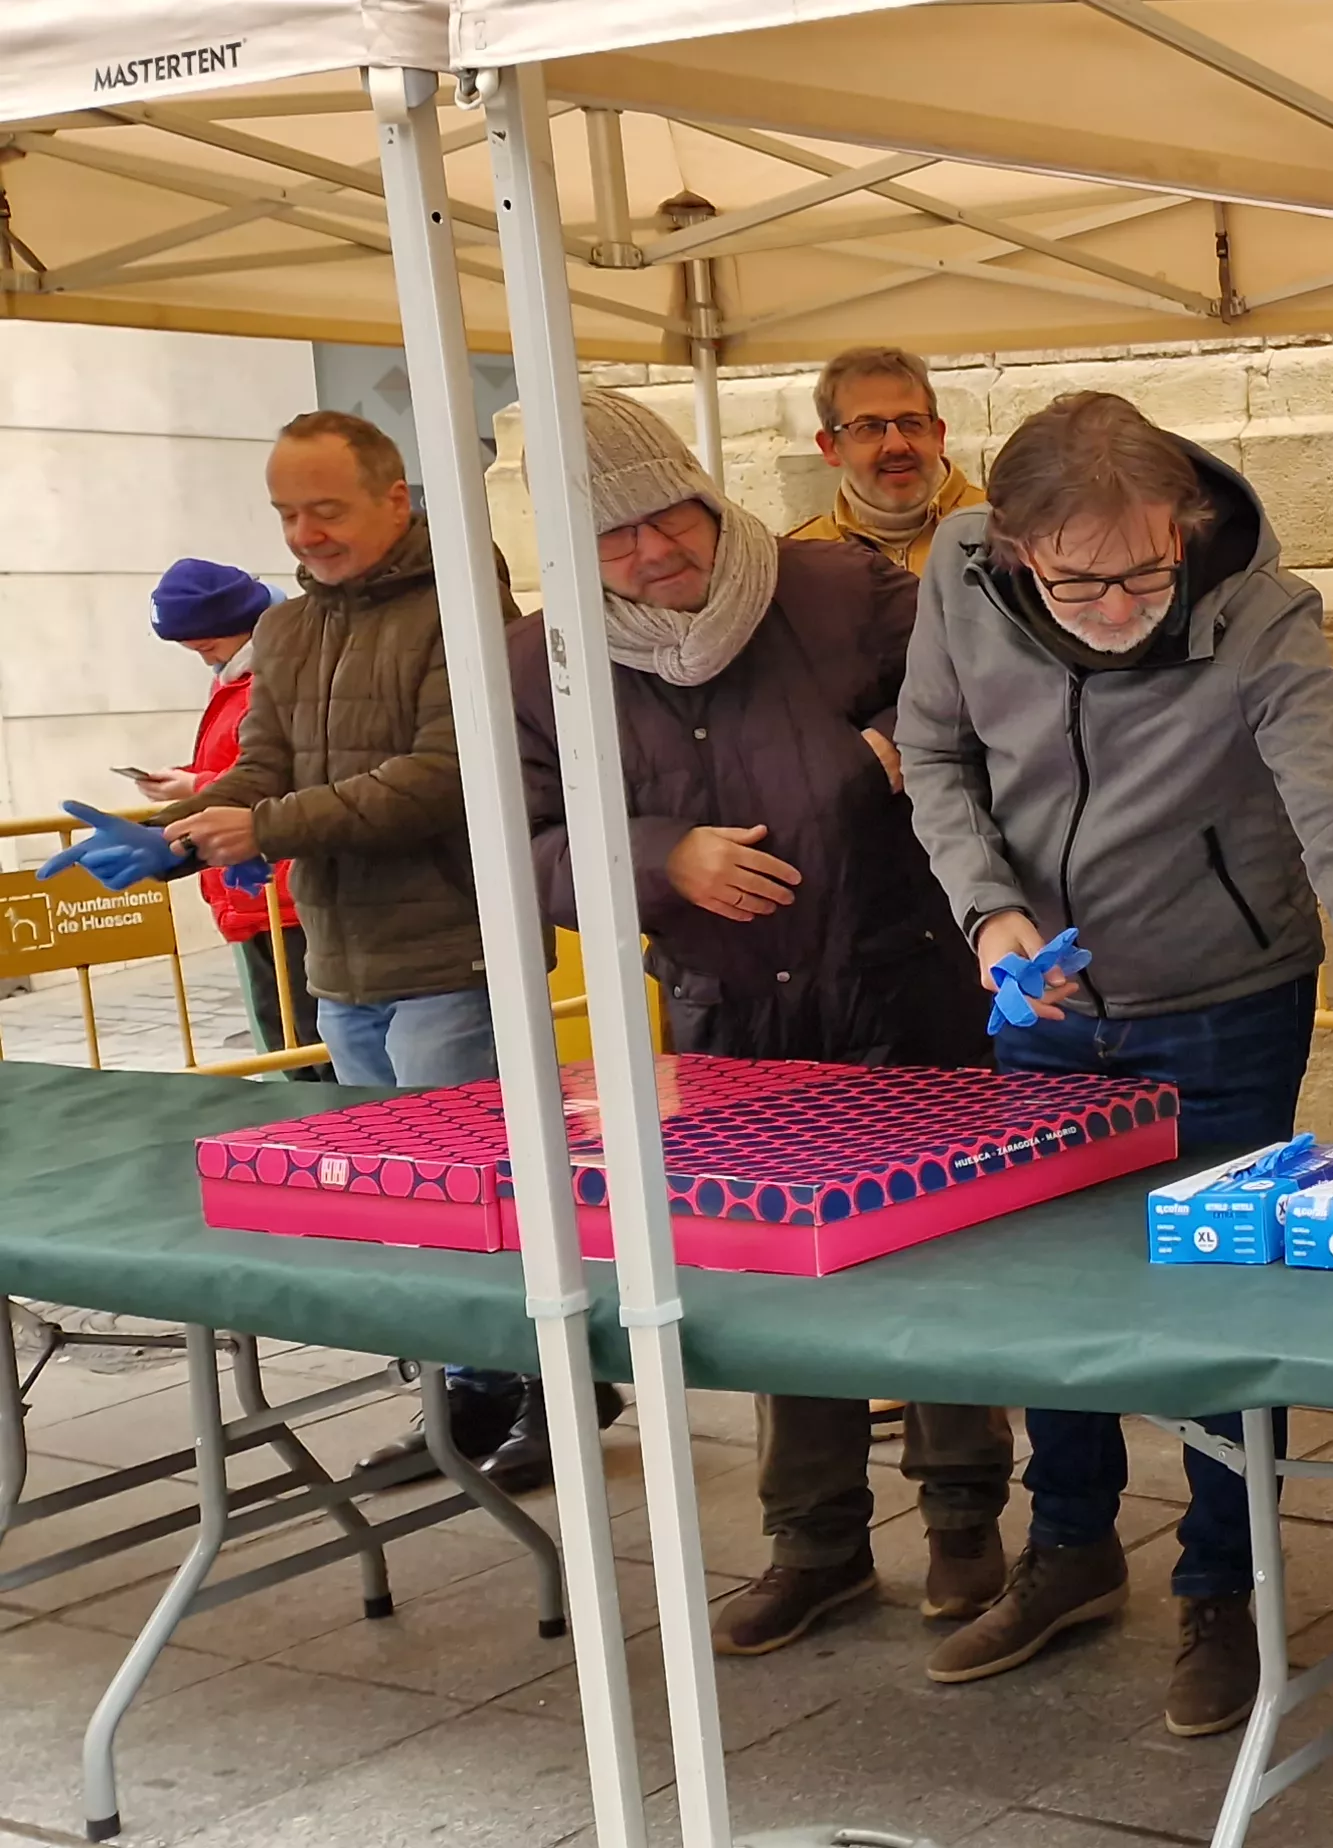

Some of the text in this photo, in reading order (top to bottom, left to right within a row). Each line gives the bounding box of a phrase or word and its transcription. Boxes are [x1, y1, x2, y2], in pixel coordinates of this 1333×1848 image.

[93, 41, 242, 92] MASTERTENT
[56, 890, 164, 918] Ayuntamiento
[57, 912, 143, 935] de Huesca
[955, 1151, 991, 1169] HUESCA
[997, 1136, 1041, 1156] ZARAGOZA
[1046, 1126, 1078, 1142] MADRID
[1197, 1231, 1215, 1243] XL
